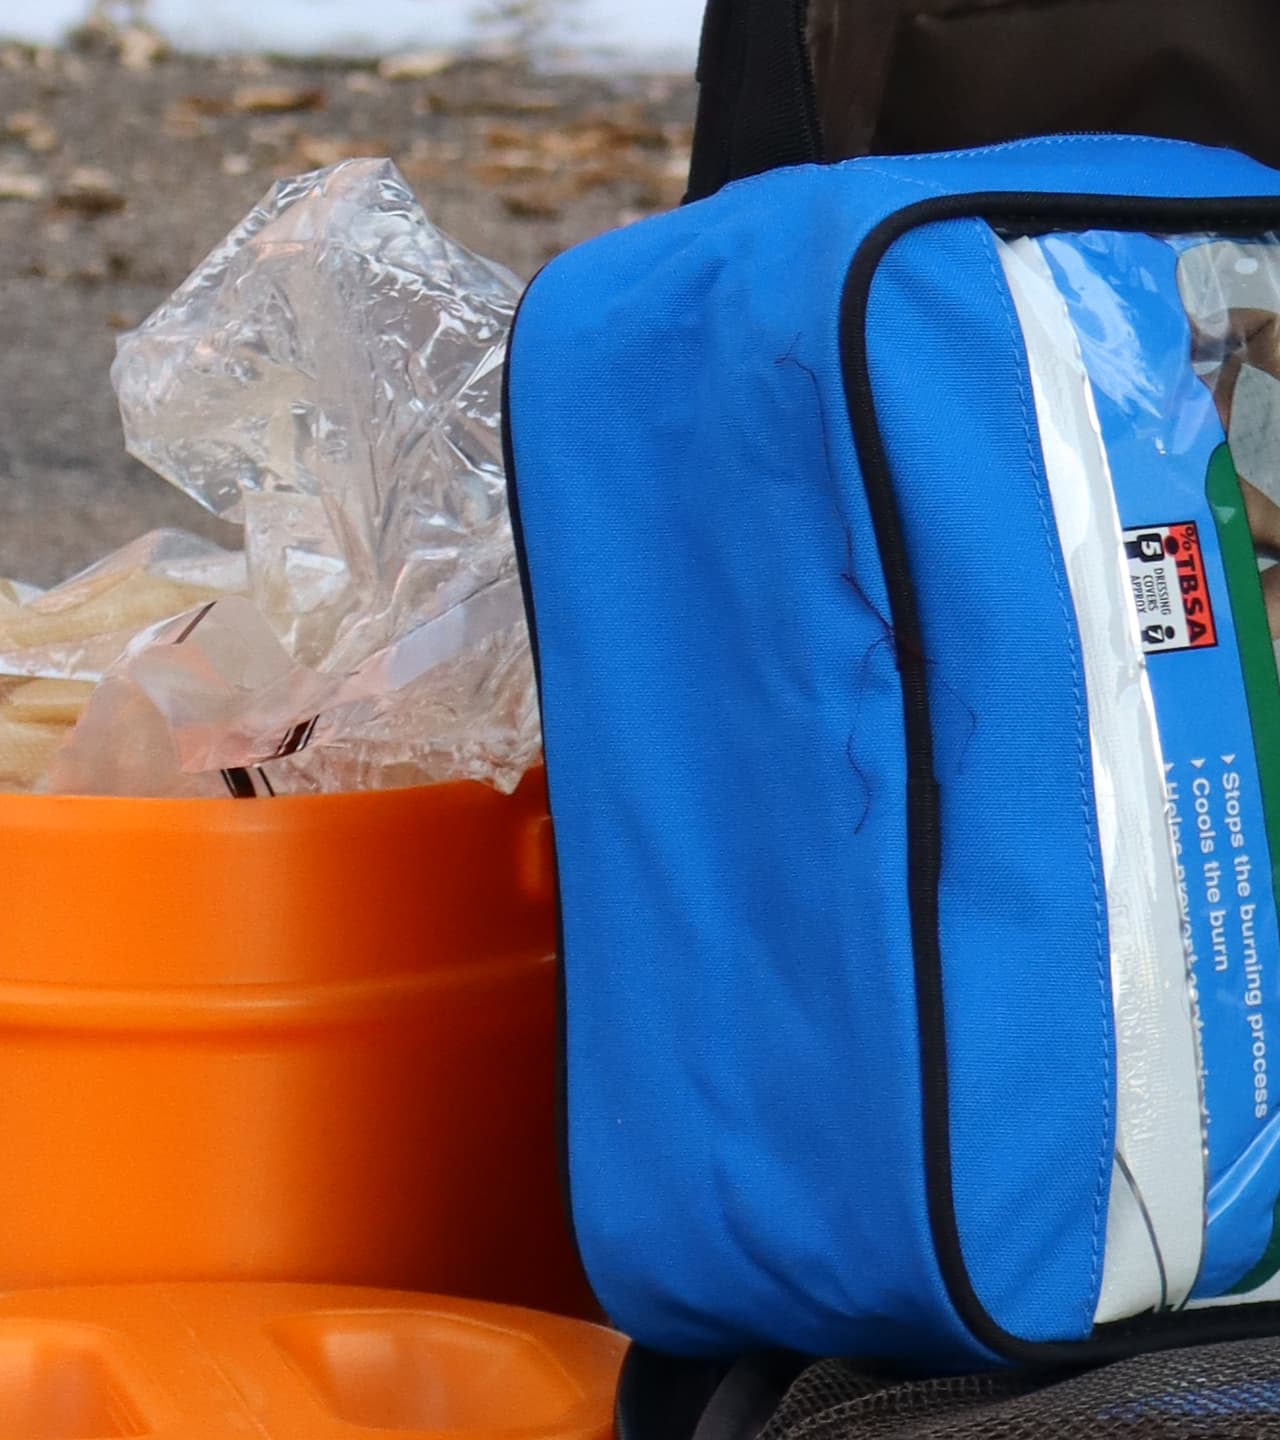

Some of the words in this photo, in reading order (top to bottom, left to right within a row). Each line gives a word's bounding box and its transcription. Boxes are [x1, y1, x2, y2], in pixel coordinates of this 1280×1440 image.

[1141, 540, 1163, 557] 5
[1143, 574, 1159, 612] COVERS
[1154, 567, 1171, 616] DRESSING
[1147, 626, 1163, 641] 7
[1192, 778, 1216, 854] Cools
[1222, 771, 1244, 848] Stops
[1203, 861, 1222, 904] the
[1234, 855, 1252, 897] the
[1209, 910, 1228, 972] burn
[1240, 904, 1264, 1008] burning
[1247, 1013, 1268, 1118] process
